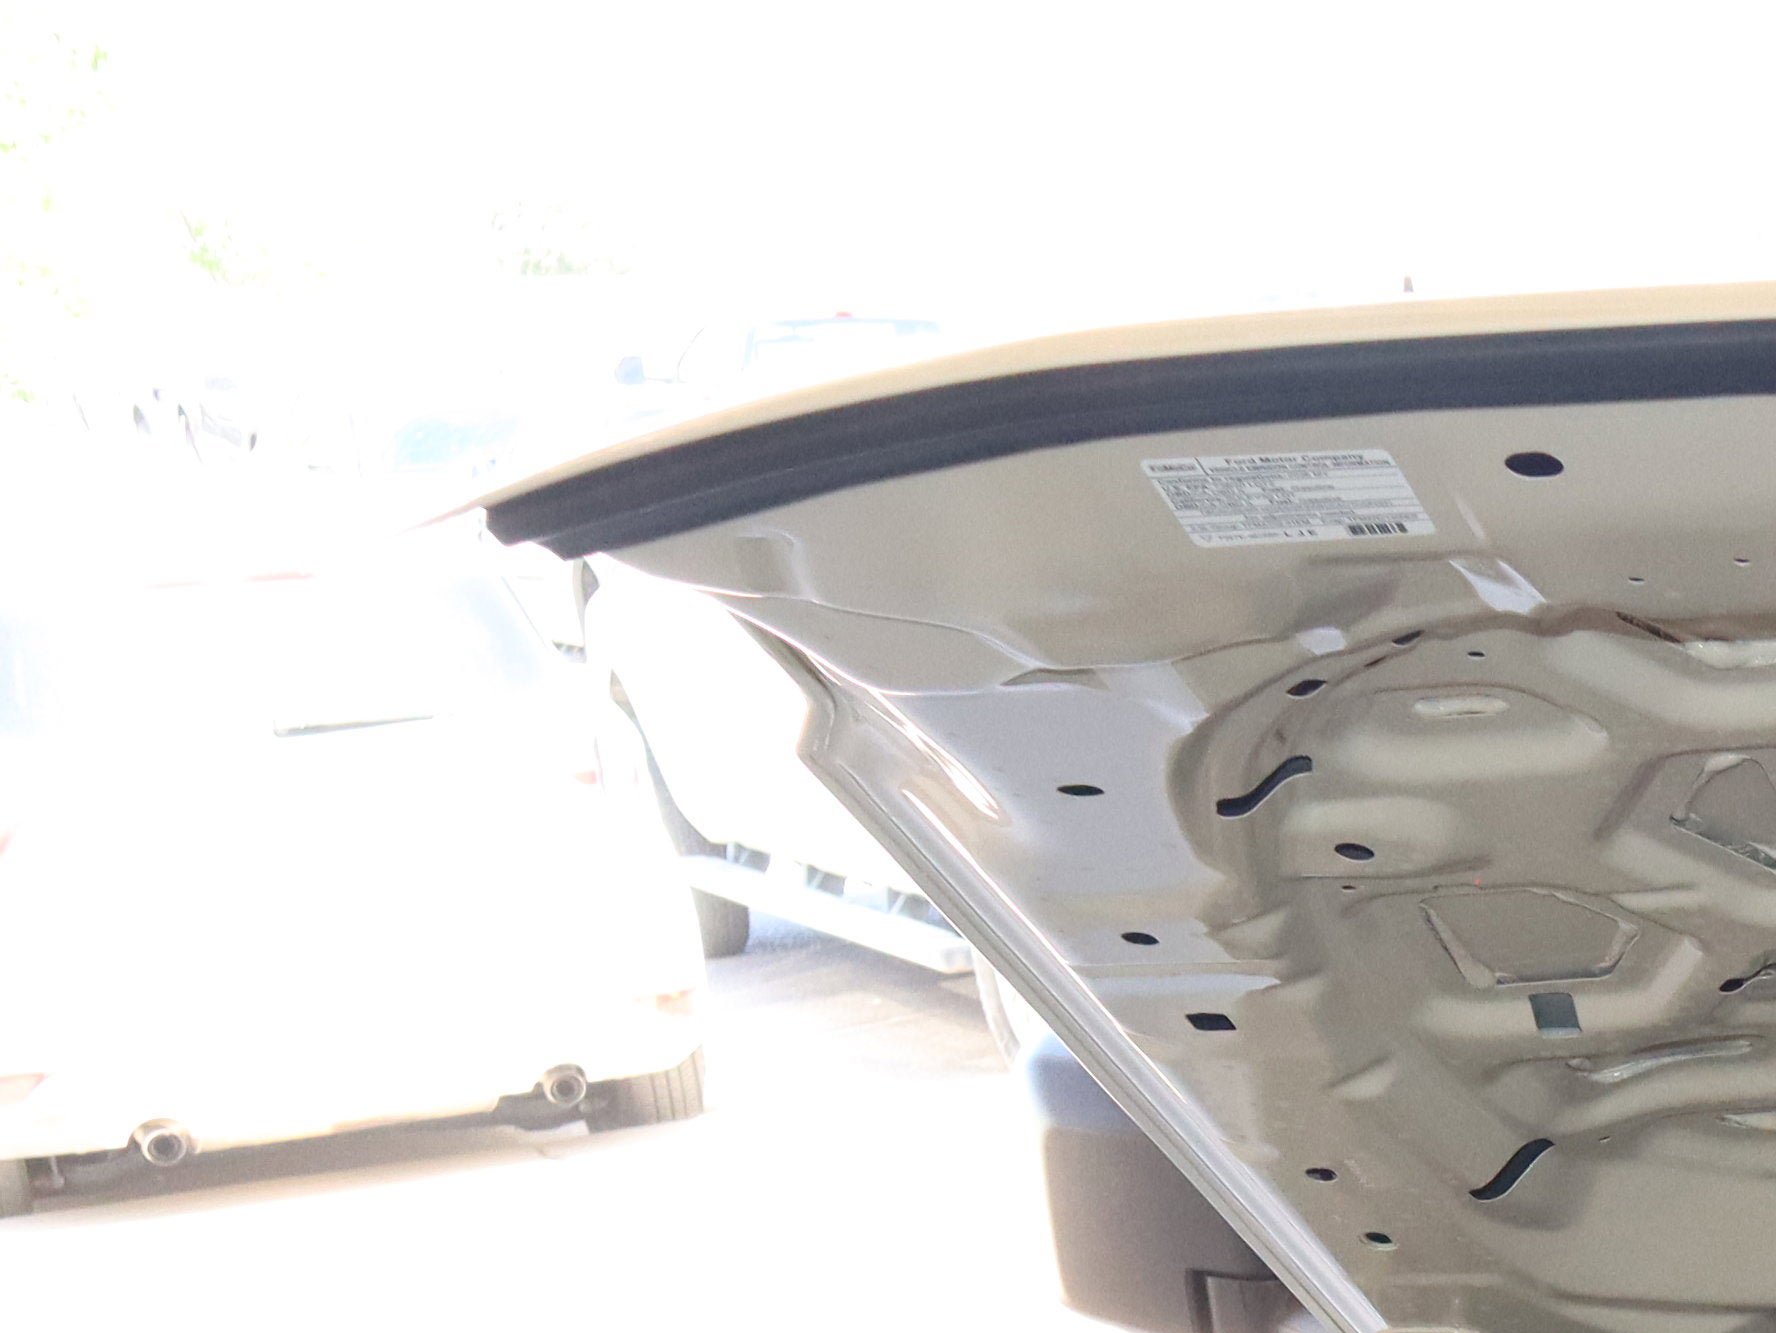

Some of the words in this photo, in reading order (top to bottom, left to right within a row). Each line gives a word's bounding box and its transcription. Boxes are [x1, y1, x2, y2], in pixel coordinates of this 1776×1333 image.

[1224, 457, 1257, 466] Ford
[1259, 456, 1297, 465] Motor
[1300, 453, 1365, 464] Company
